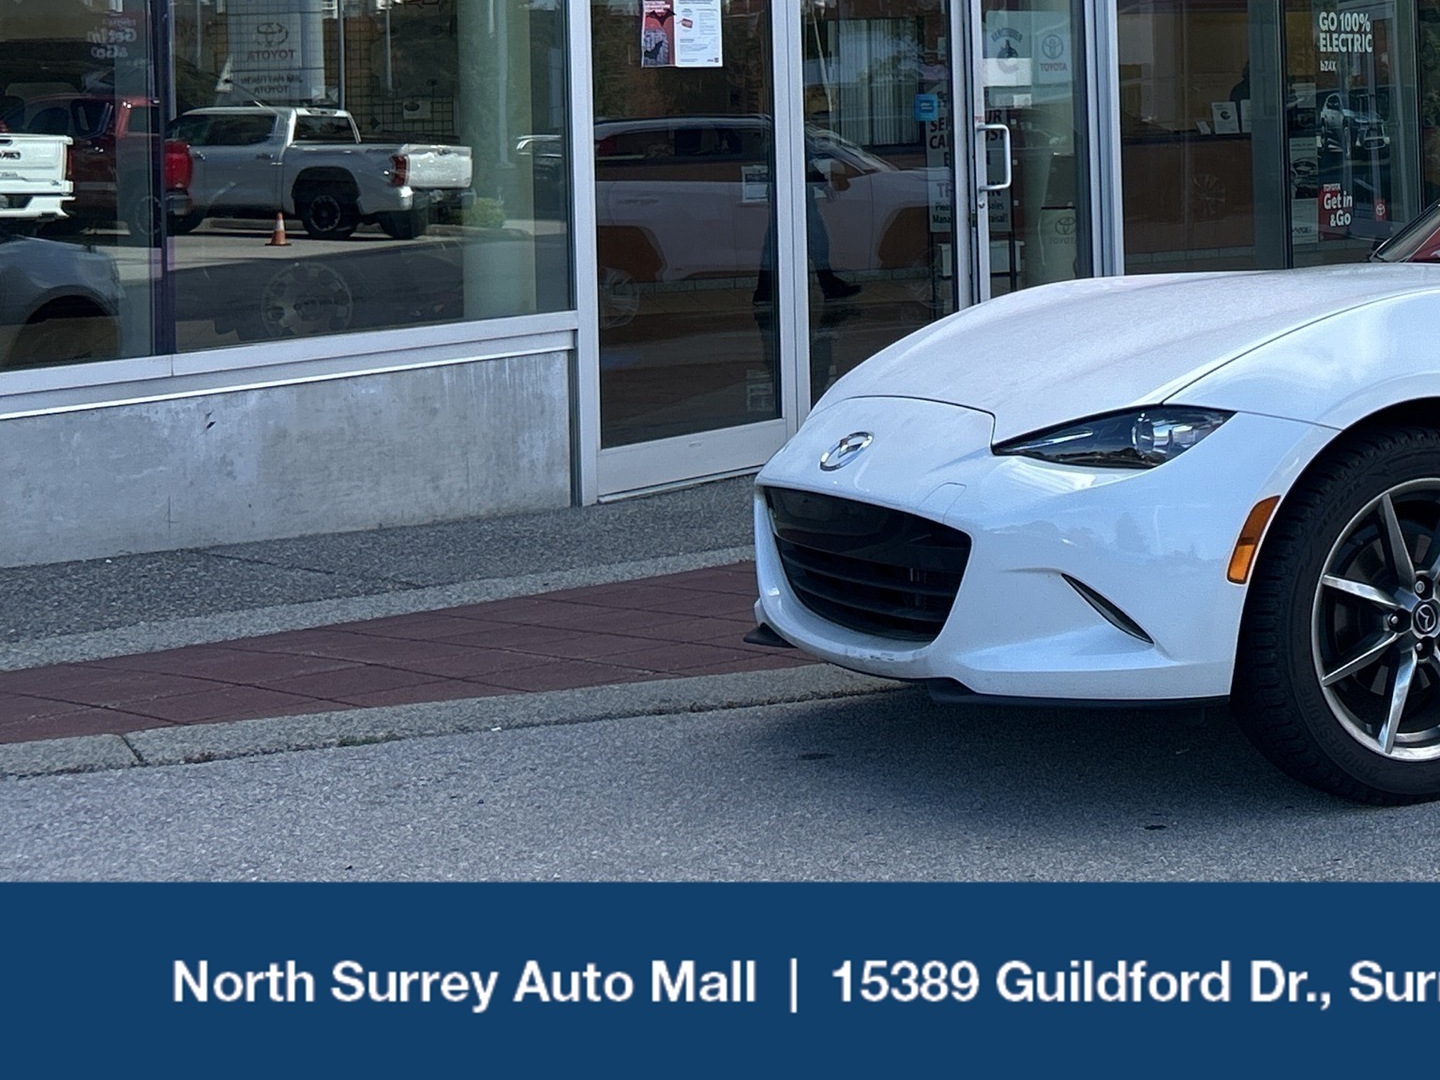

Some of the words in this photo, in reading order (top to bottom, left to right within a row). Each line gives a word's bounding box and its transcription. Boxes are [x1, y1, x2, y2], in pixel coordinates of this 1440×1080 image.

[1319, 11, 1338, 31] GO
[1339, 12, 1371, 32] 100%
[1319, 32, 1373, 53] ELECTRIC
[1323, 193, 1342, 210] Get
[1342, 191, 1353, 208] in
